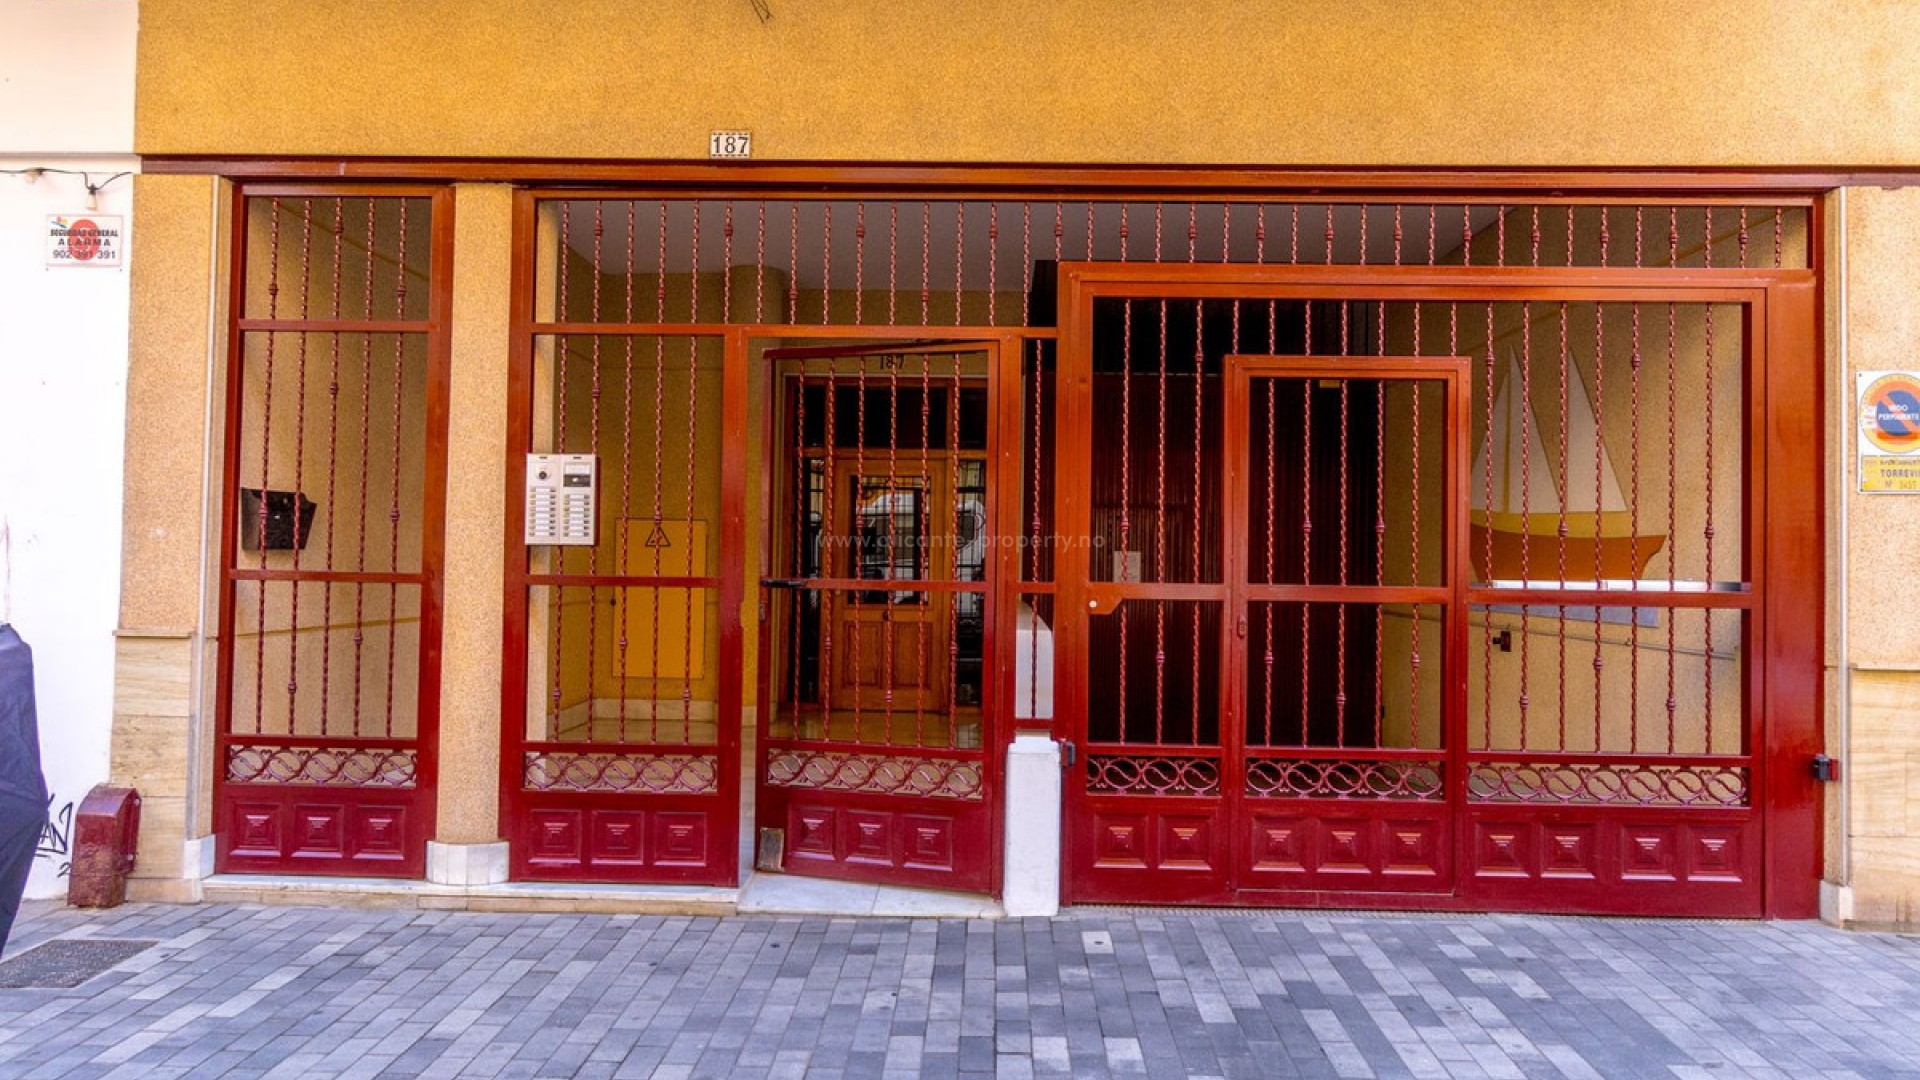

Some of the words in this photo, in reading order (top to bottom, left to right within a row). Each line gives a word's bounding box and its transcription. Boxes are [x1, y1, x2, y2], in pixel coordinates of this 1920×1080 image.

[713, 136, 749, 154] 187
[53, 250, 73, 259] 902
[97, 250, 116, 259] 391
